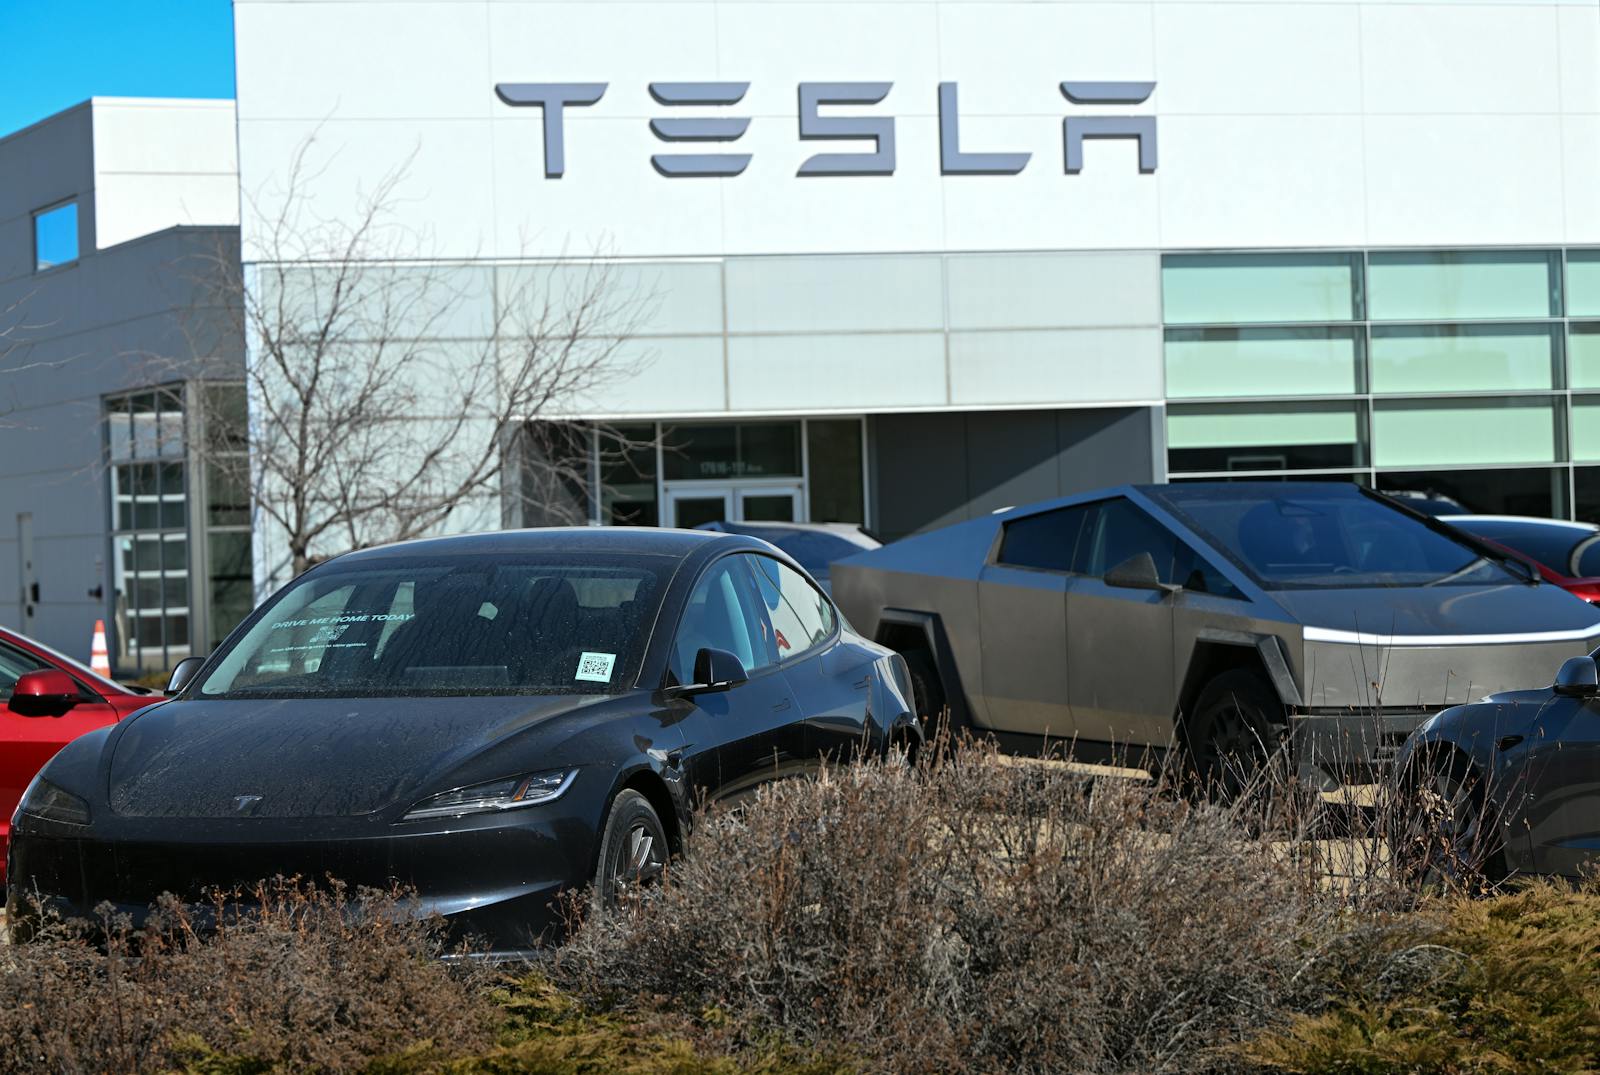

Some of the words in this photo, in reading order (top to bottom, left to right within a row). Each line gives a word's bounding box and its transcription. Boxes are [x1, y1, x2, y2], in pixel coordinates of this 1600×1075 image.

[495, 81, 1159, 180] TESLA
[271, 619, 307, 629] DRIVE
[309, 617, 329, 625] ME
[330, 615, 369, 623] HOME
[371, 613, 415, 621] TODAY
